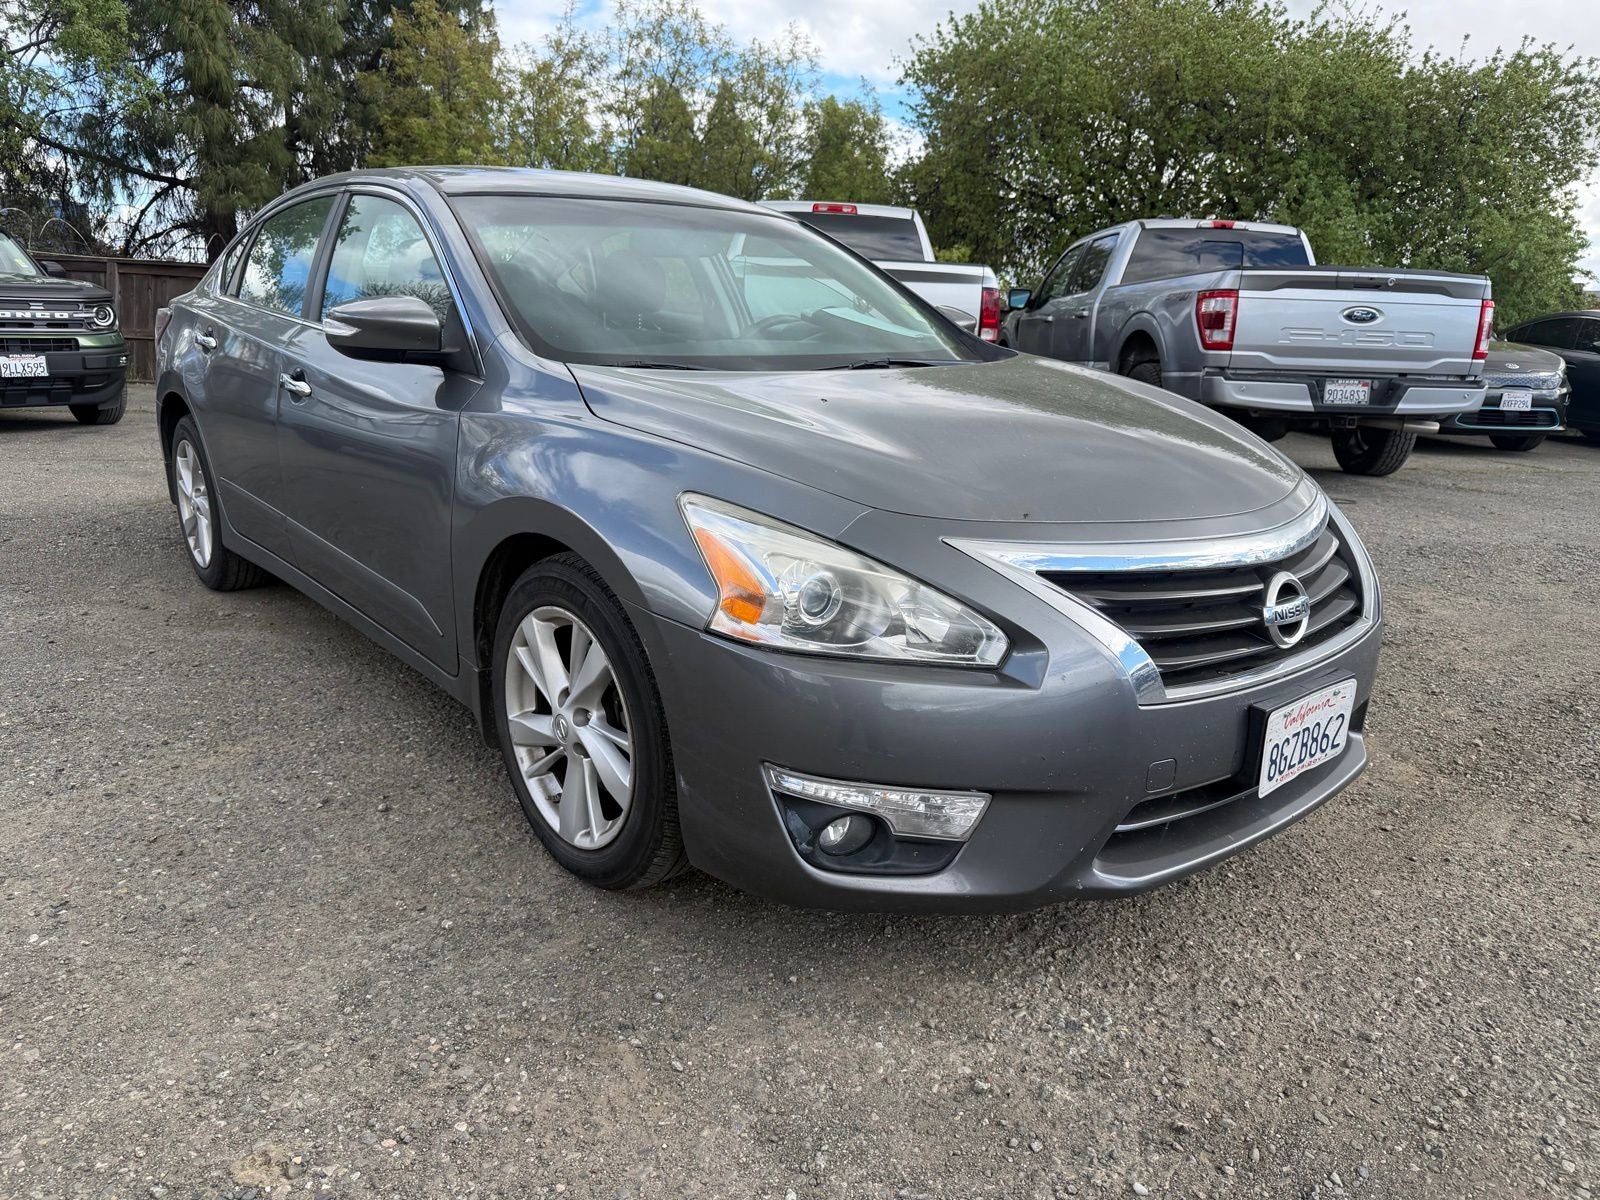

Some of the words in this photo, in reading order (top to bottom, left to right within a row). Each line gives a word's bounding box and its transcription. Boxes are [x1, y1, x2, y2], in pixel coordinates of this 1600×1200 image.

[1278, 327, 1435, 348] F-150
[2, 362, 46, 375] 9LLX595
[1274, 602, 1310, 621] NISSAN
[1283, 698, 1337, 730] California
[1267, 712, 1346, 783] 8GZB862
